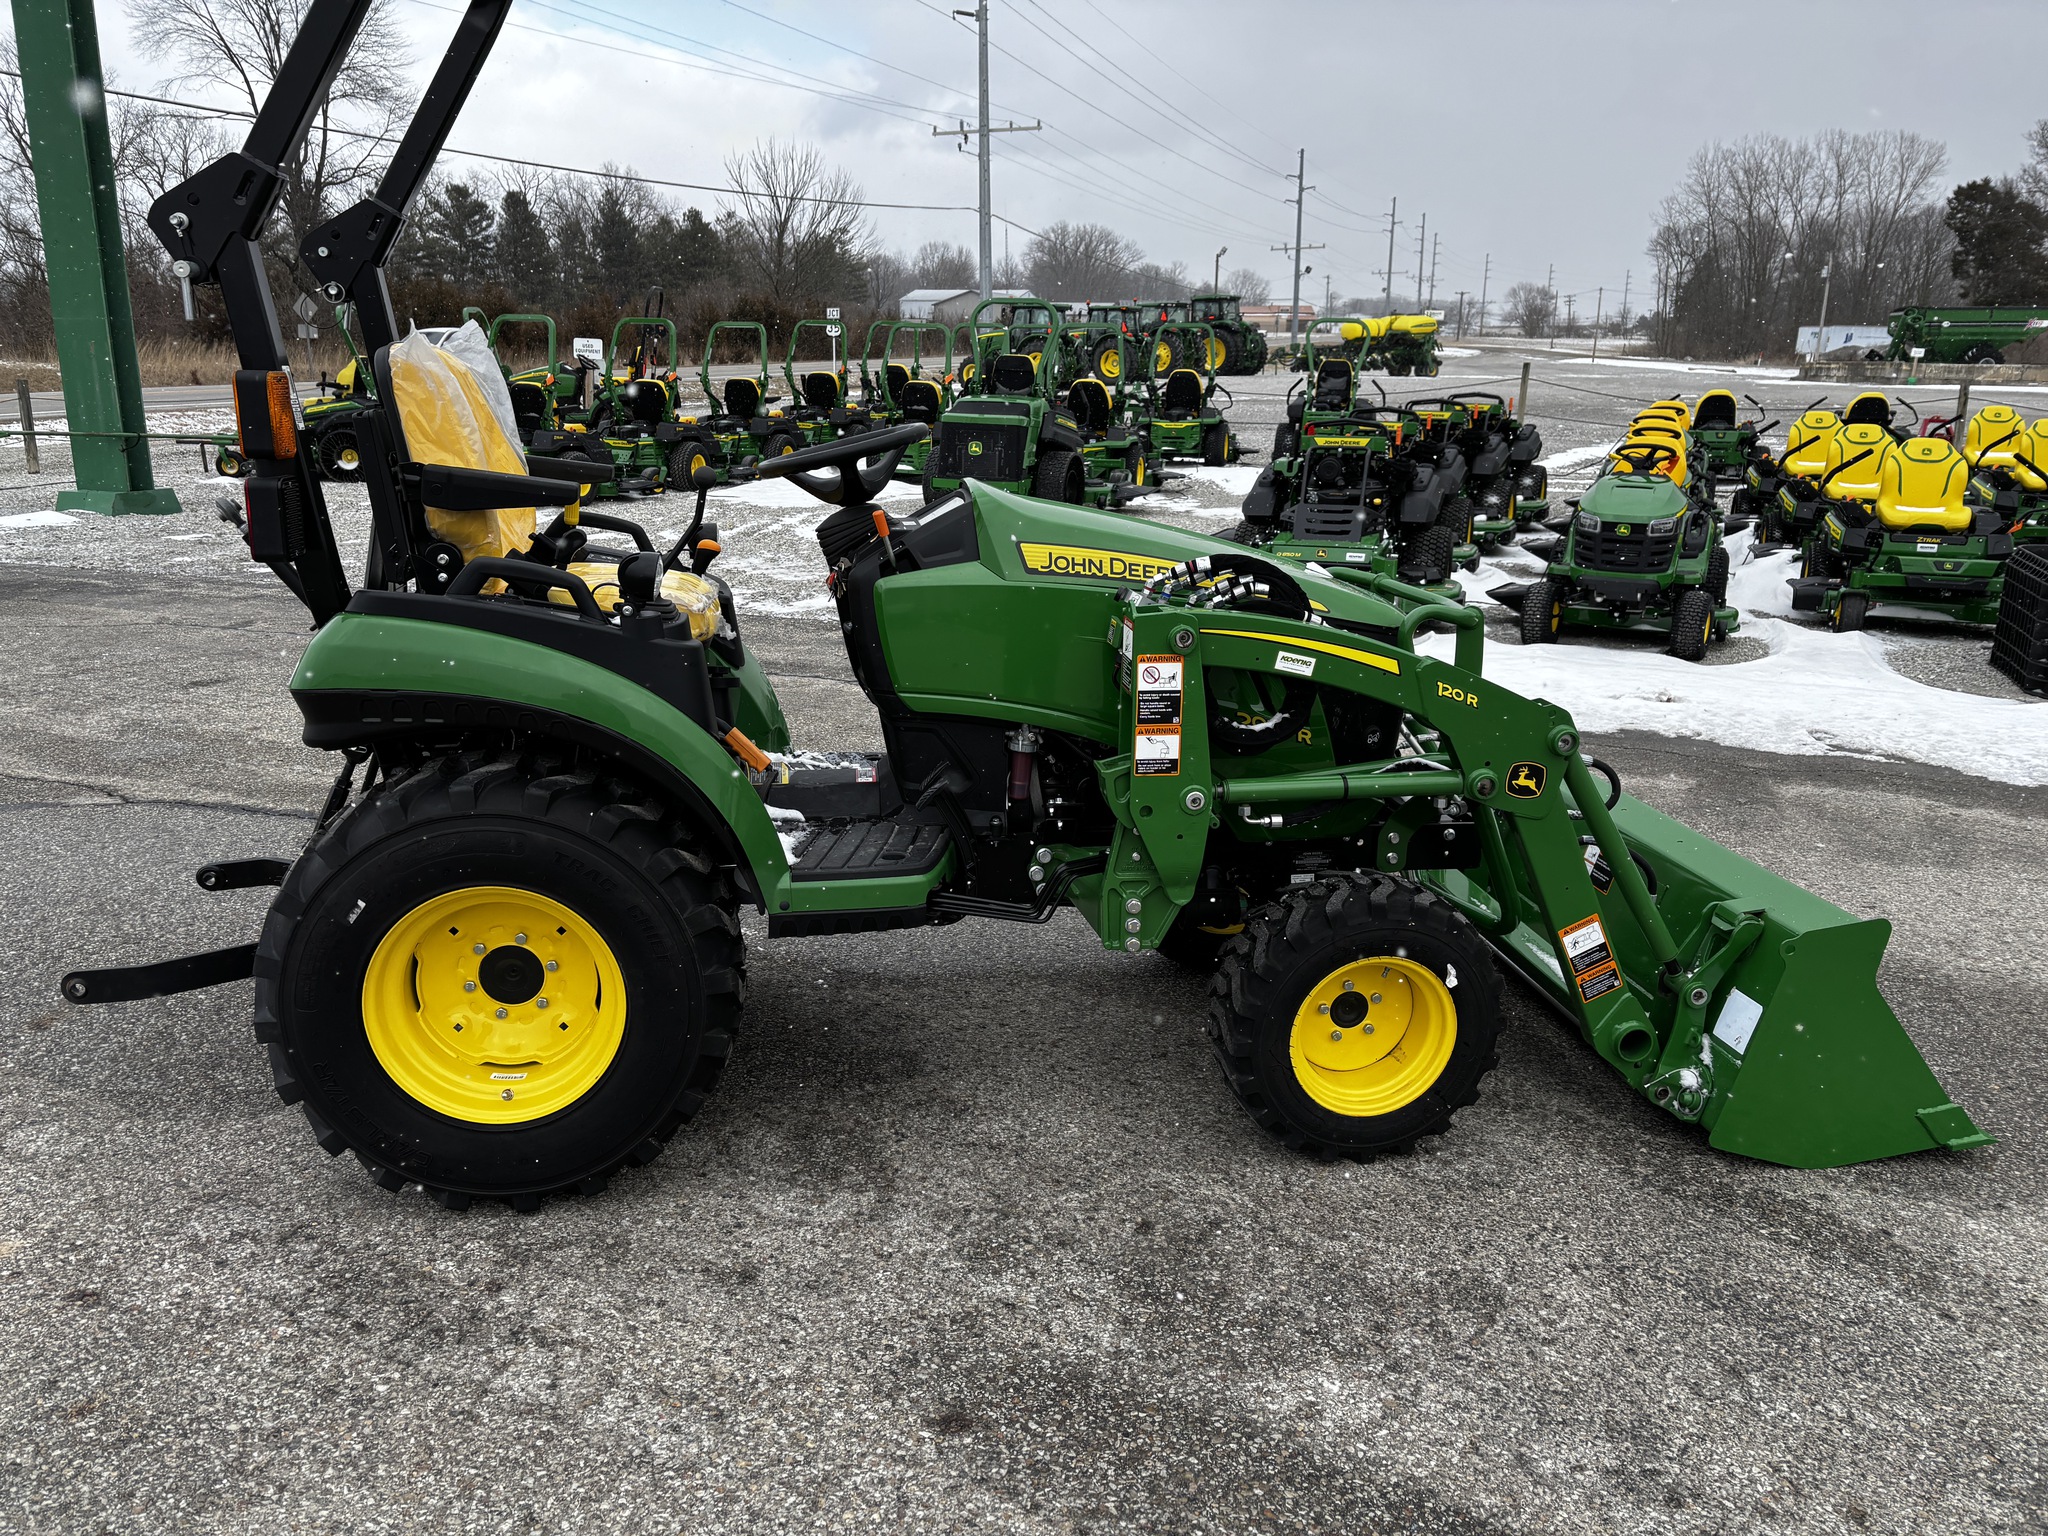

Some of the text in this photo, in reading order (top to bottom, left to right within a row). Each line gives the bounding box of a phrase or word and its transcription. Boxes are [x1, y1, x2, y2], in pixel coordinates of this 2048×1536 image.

[827, 309, 839, 317] JCT
[1040, 552, 1171, 579] JOHN DEER
[1146, 655, 1181, 663] WARNING
[1436, 680, 1479, 709] 120 R
[1144, 727, 1179, 735] WARNING
[1297, 728, 1313, 746] R
[1569, 917, 1595, 932] WARNING
[1587, 964, 1612, 978] WARNING
